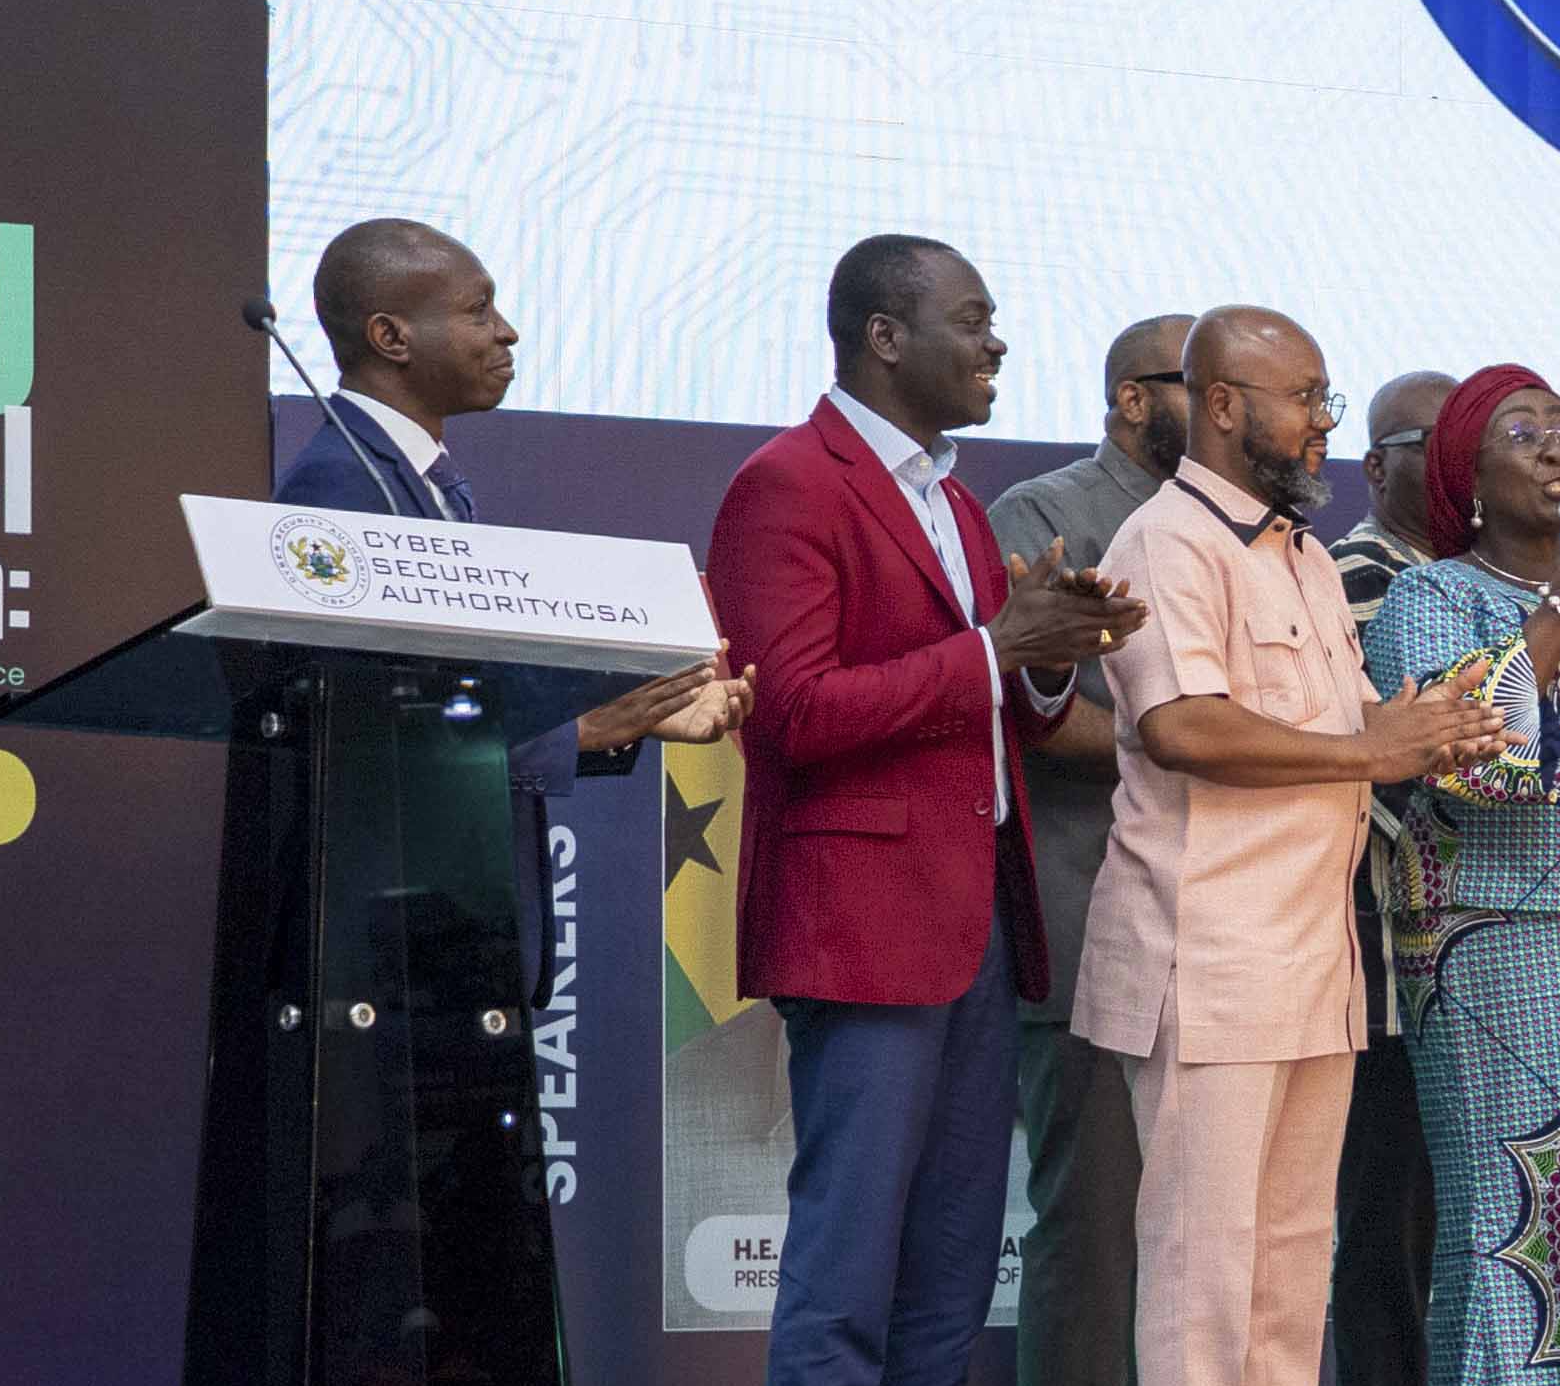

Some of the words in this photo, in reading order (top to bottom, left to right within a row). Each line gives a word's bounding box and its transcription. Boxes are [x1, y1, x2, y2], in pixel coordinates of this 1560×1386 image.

[362, 530, 472, 558] CYBER
[371, 557, 531, 589] SECURITY
[734, 1239, 779, 1261] H.E.
[734, 1269, 781, 1288] PRES
